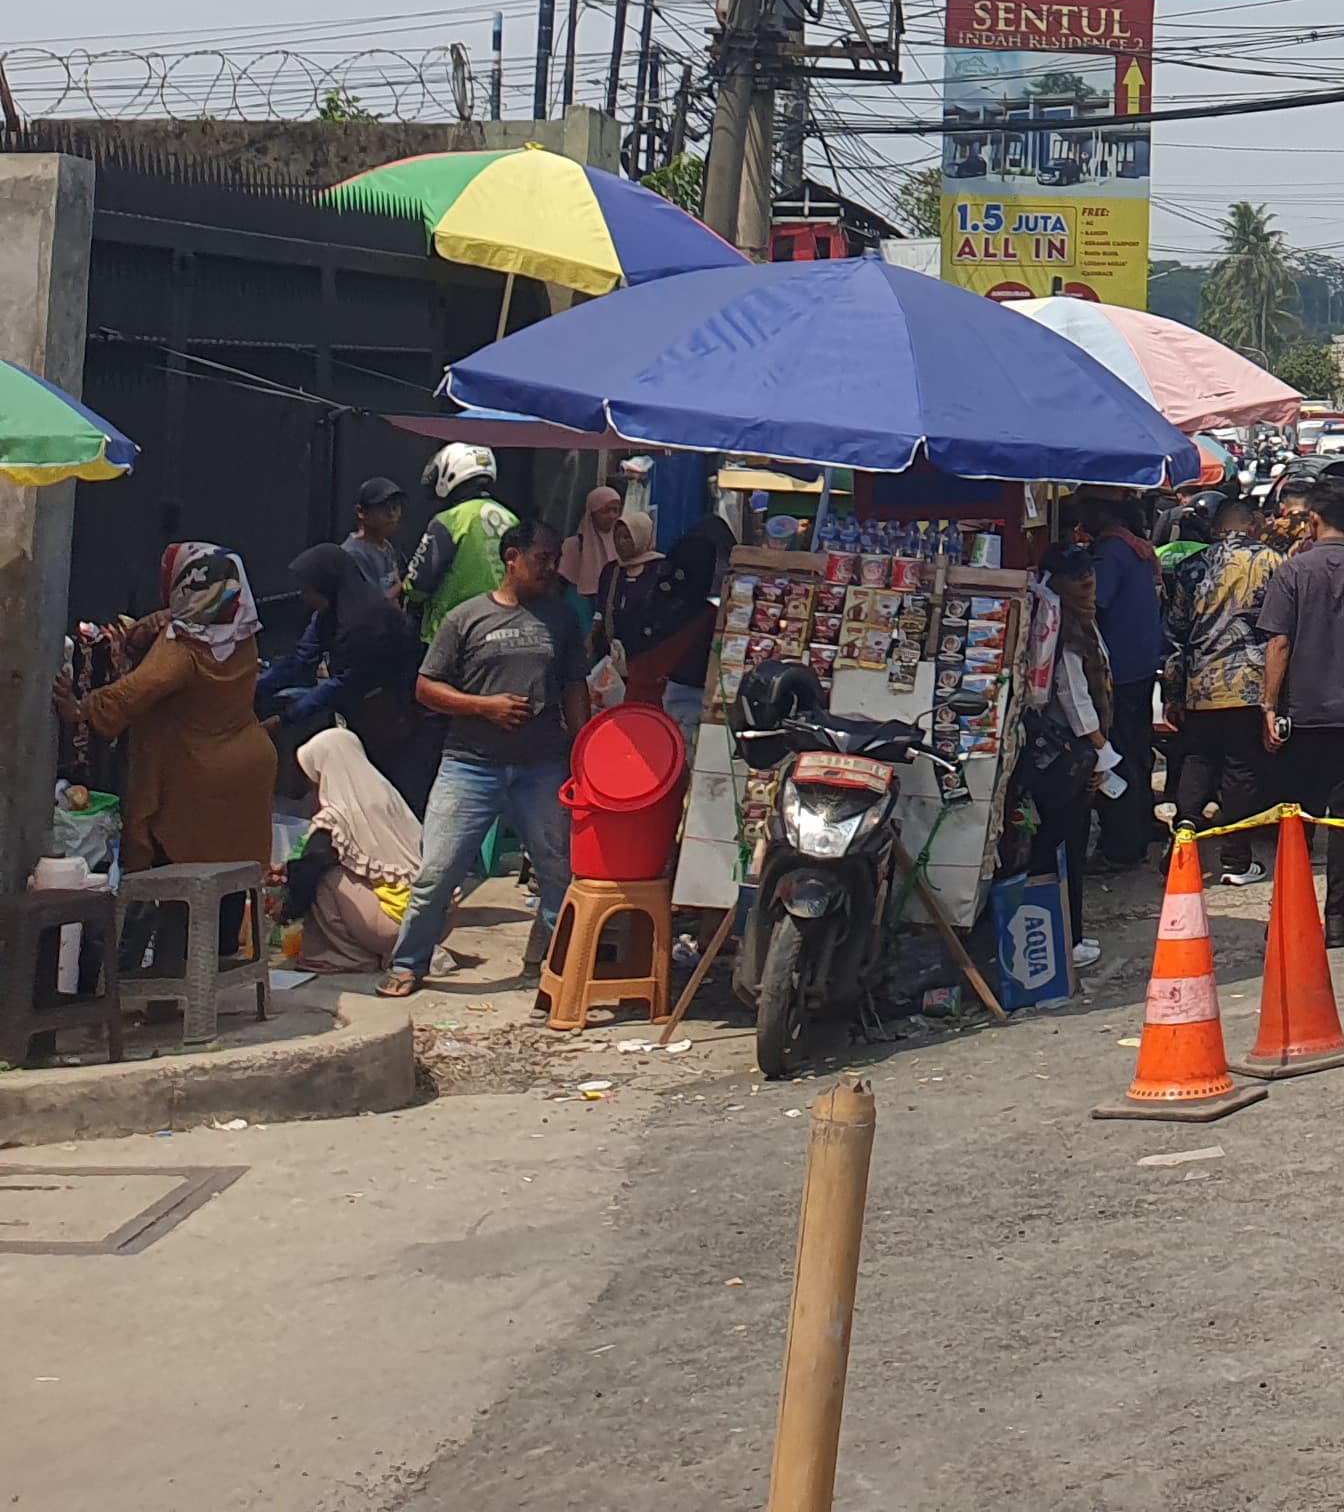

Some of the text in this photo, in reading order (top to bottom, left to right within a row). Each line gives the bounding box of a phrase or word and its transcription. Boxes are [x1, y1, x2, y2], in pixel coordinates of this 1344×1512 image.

[972, 0, 1131, 37] SENTUL
[959, 32, 1022, 47] INDAH
[1029, 33, 1129, 51] RESIDENCE
[957, 204, 1069, 234] 1.5 JUTA
[956, 237, 1068, 261] ALL IN
[1024, 916, 1050, 978] AQUA
